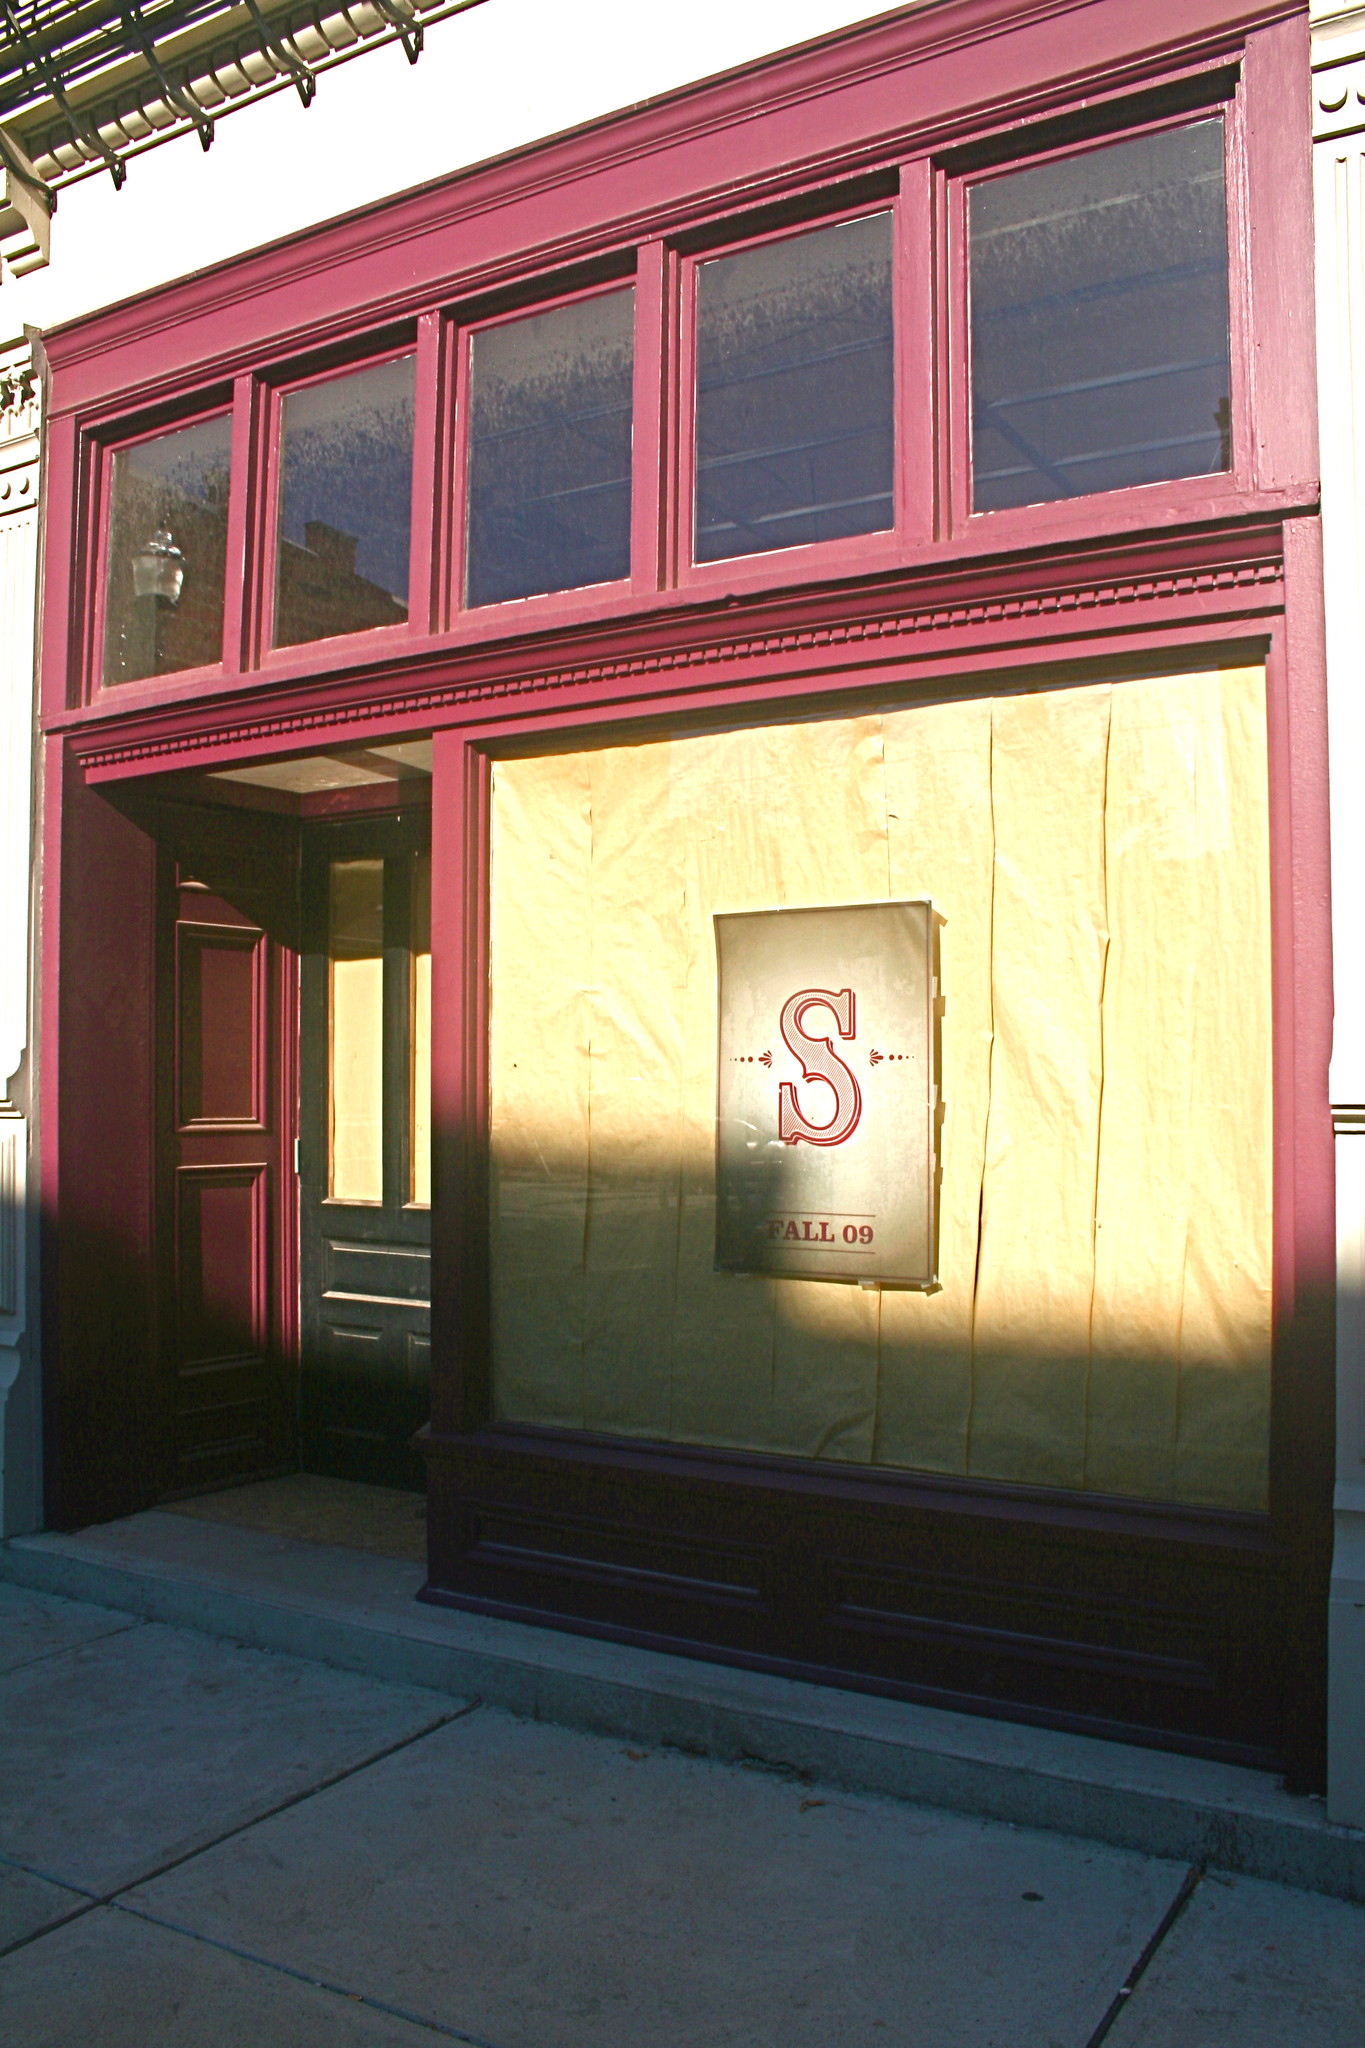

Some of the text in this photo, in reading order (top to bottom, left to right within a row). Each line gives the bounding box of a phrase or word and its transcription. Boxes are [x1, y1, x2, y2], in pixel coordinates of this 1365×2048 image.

[778, 988, 862, 1146] S
[767, 1220, 874, 1244] FALL 09
